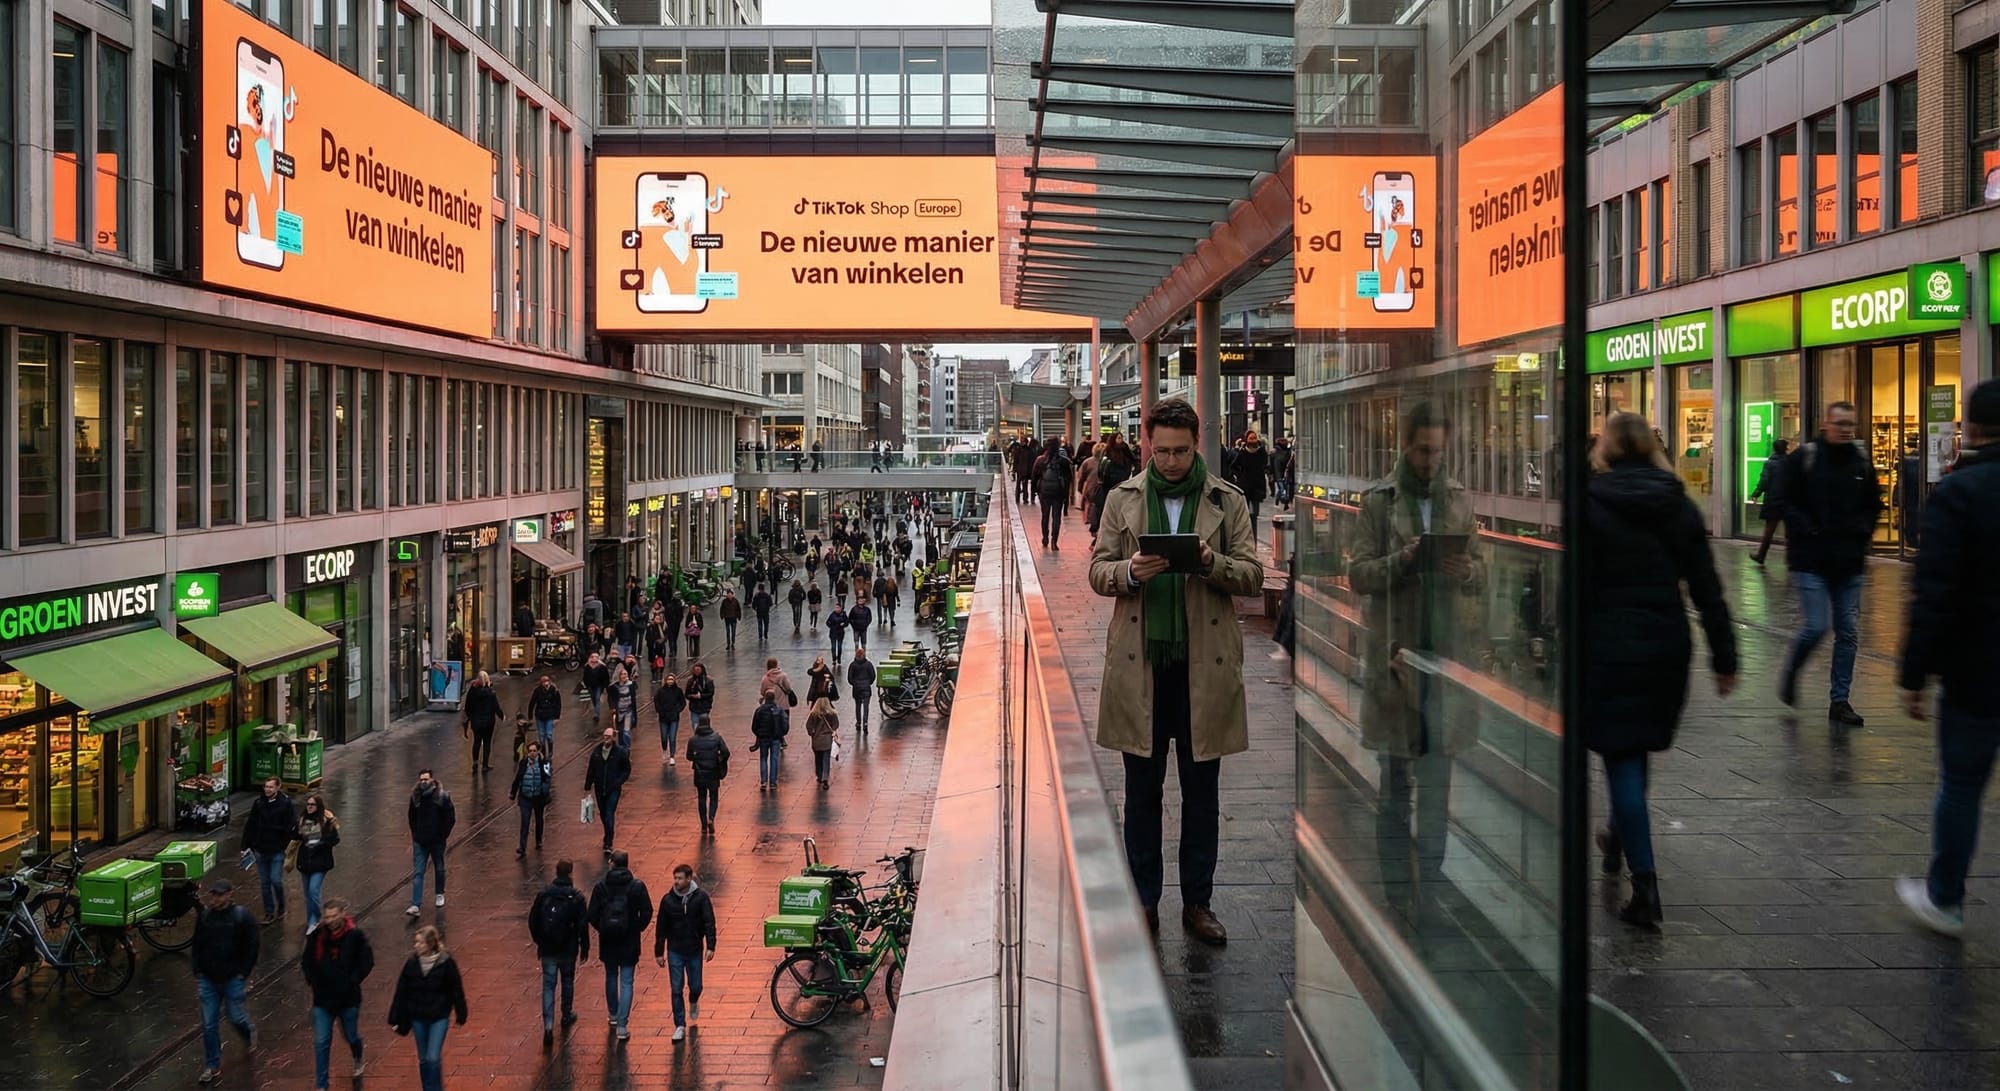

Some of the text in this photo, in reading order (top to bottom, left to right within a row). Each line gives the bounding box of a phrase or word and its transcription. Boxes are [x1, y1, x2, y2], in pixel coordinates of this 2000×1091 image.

[321, 127, 483, 231] De nieuwe manier
[812, 201, 957, 218] TikTok Shop Europe
[346, 208, 383, 249] van
[386, 216, 465, 274] winkelen
[760, 230, 995, 253] De nieuwe manier
[791, 261, 964, 284] van winkelen
[1606, 321, 1707, 362] GROEN INVEST
[306, 549, 355, 584] ECORP
[0, 583, 159, 640] GROEN INVEST
